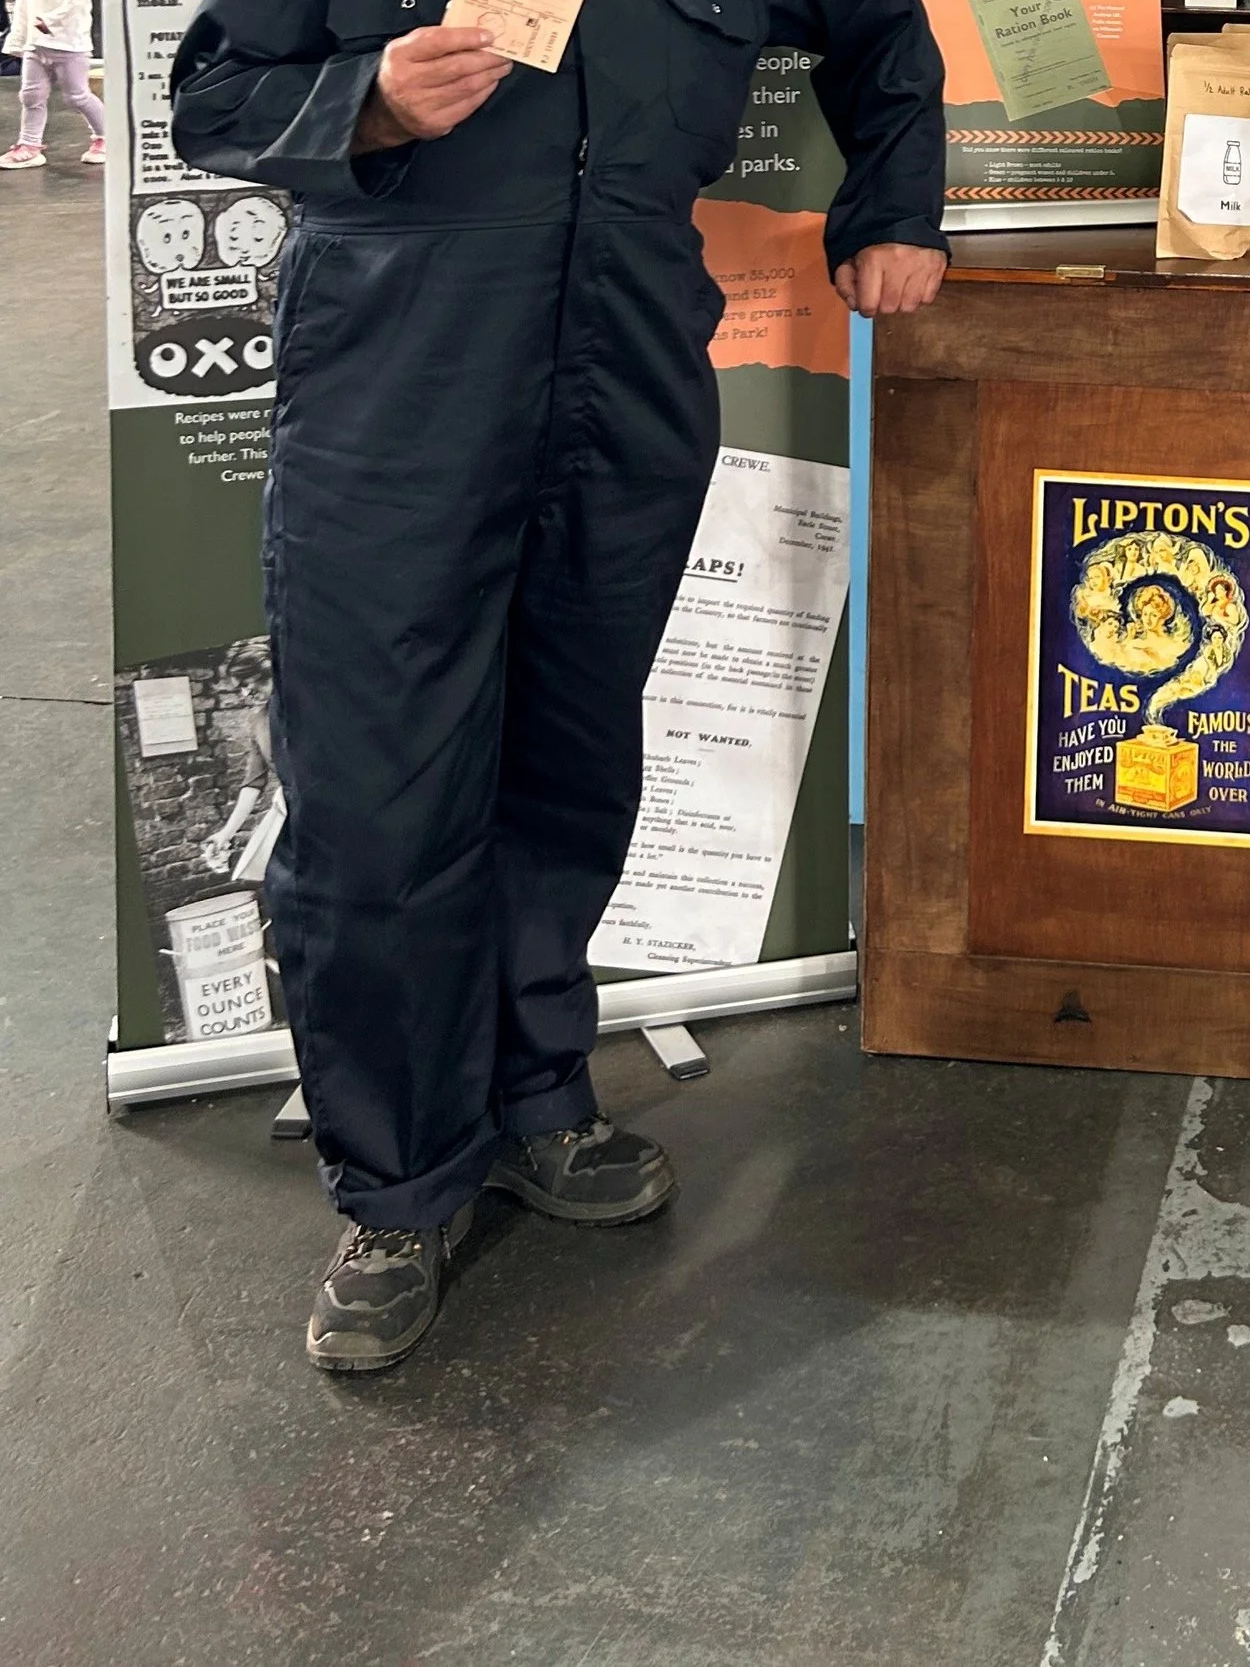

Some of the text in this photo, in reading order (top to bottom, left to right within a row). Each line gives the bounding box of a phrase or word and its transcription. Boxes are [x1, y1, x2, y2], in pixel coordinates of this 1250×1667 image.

[1010, 2, 1042, 17] Your
[995, 20, 1036, 39] Ration
[1040, 8, 1072, 26] Book
[753, 88, 801, 105] their
[761, 122, 778, 138] in
[741, 156, 801, 178] parks.
[1221, 200, 1241, 212] Milk
[167, 273, 251, 289] WE ARE SMALL
[168, 288, 248, 304] BUT SO GOOD
[150, 335, 274, 378] OXO
[175, 409, 261, 425] Recipes were
[179, 431, 226, 445] to help
[188, 447, 268, 465] further. This
[721, 455, 770, 472] CREWE.
[221, 468, 264, 482] Crewe
[1072, 498, 1250, 549] LIPTON'S
[1057, 663, 1141, 719] TEAS
[666, 729, 691, 739] NOT
[1058, 714, 1126, 748] HAVE YOU
[1213, 740, 1237, 753] THE
[1053, 746, 1114, 772] ENJOYED
[1064, 774, 1104, 794] THEM
[1209, 787, 1248, 802] OVER
[202, 971, 252, 996] EVERY
[197, 987, 262, 1016] OUNCE
[201, 1006, 265, 1035] COUNTS
